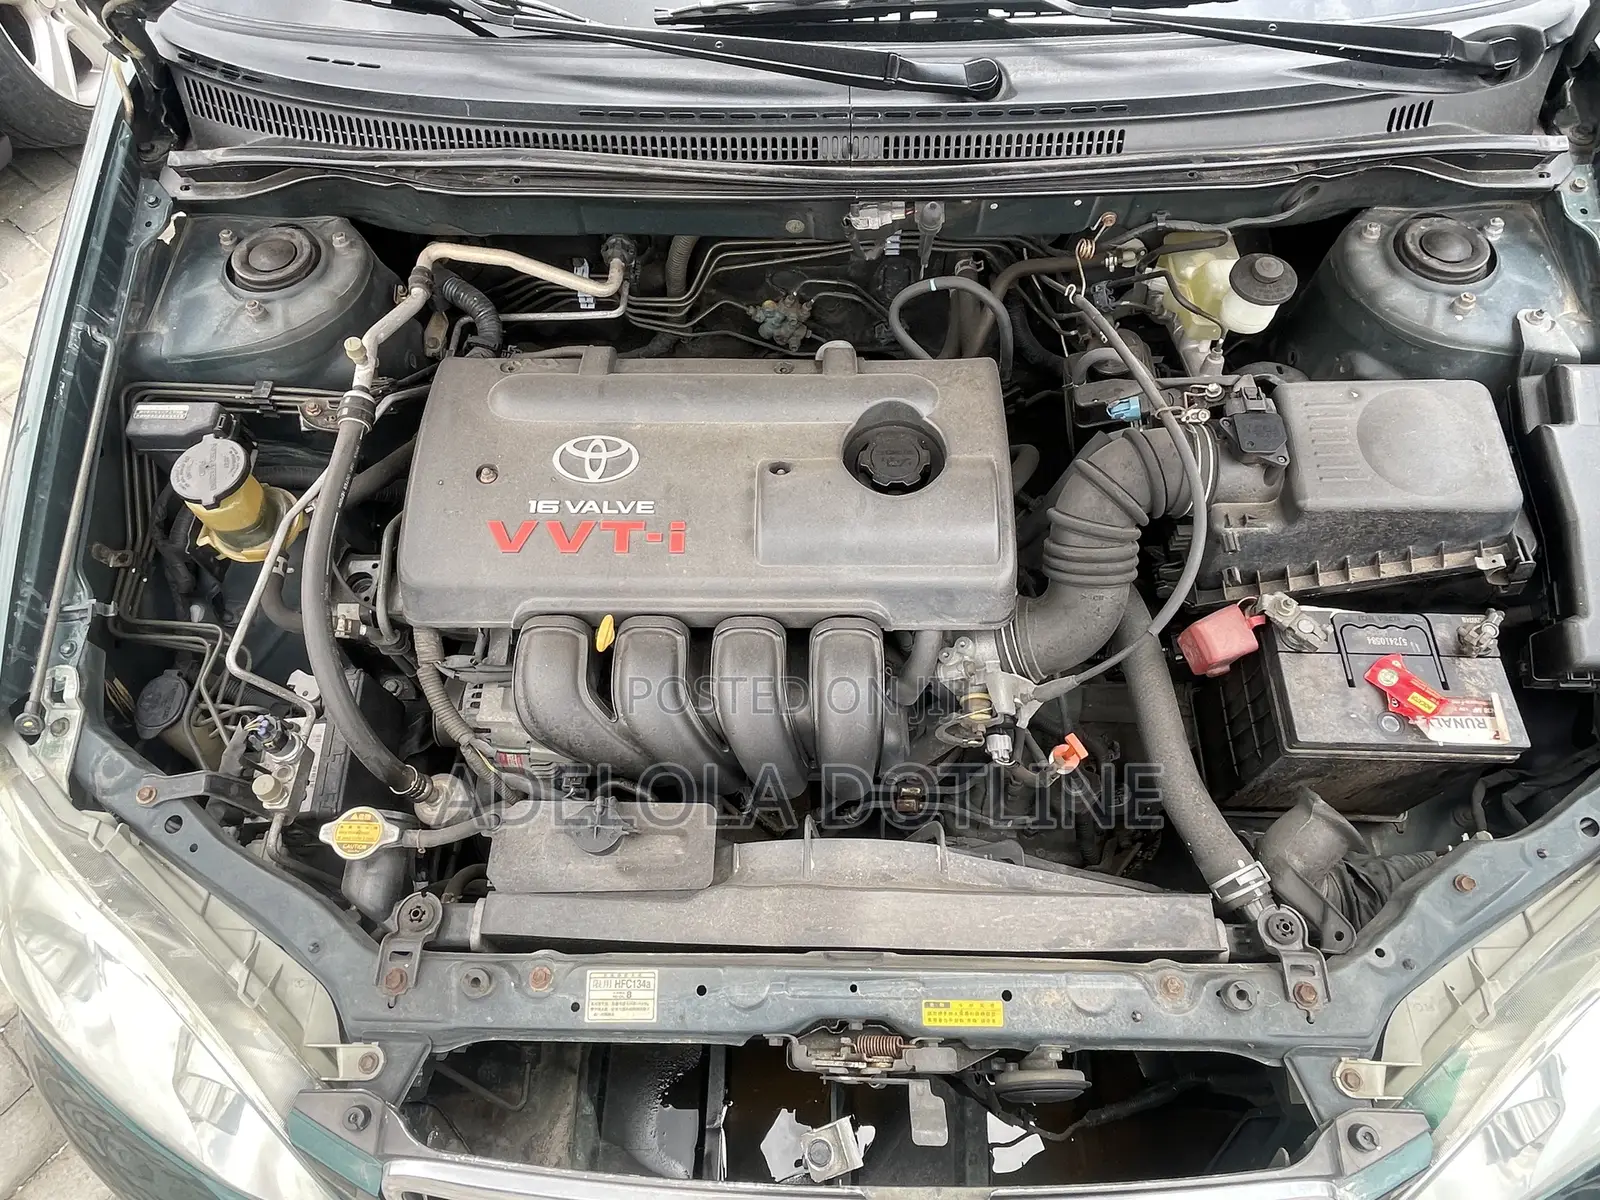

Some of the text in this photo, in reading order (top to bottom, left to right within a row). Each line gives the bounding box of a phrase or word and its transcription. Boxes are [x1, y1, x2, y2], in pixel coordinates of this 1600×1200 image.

[528, 500, 655, 514] 16 VALVE
[486, 519, 686, 553] VVT-i
[614, 979, 651, 989] HFC134a
